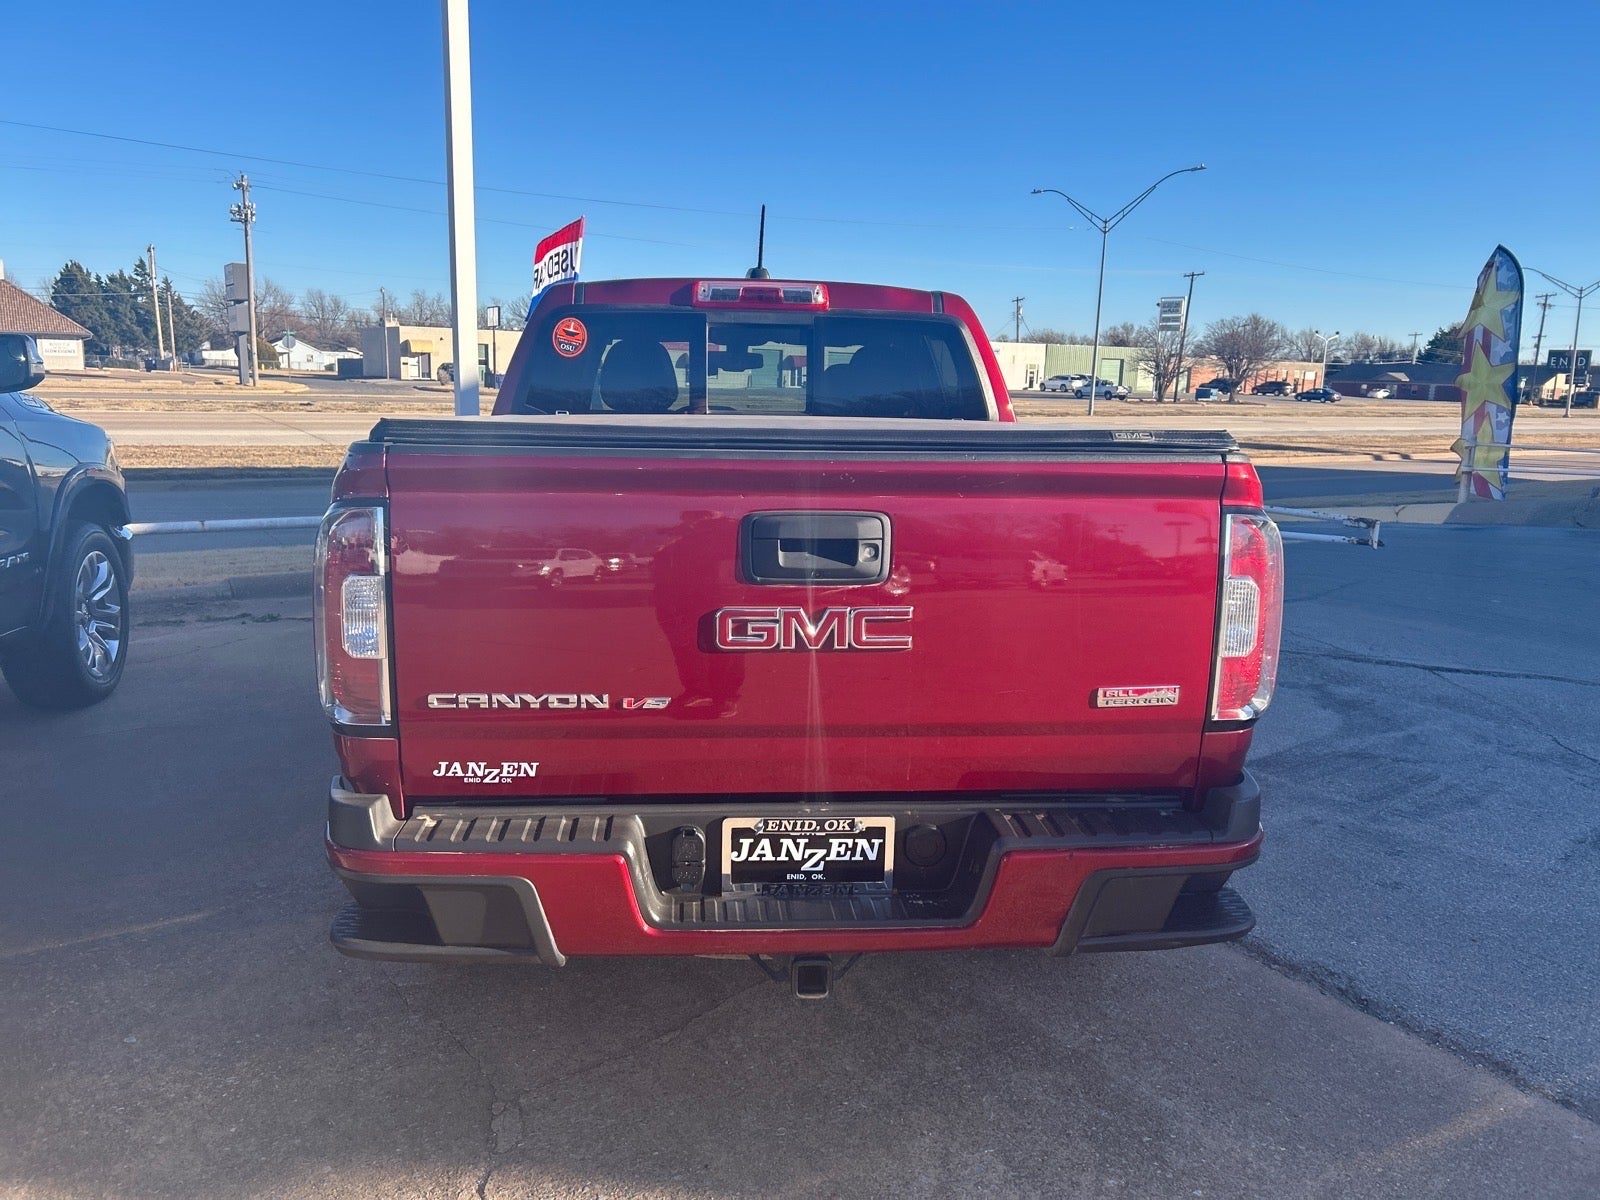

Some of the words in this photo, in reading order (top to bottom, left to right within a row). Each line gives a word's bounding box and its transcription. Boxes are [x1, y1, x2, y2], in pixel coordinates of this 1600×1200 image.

[560, 343, 575, 352] OSU
[1550, 357, 1586, 366] END
[715, 606, 914, 650] GMC
[1104, 689, 1139, 698] ALL
[427, 693, 609, 709] CANYON
[622, 697, 672, 709] V6
[1102, 697, 1176, 706] TERRAIN
[432, 761, 540, 784] JANZEN
[765, 819, 820, 832] ENID,
[824, 819, 853, 832] OK
[730, 838, 883, 872] JANZEN
[786, 873, 807, 881] ENID,
